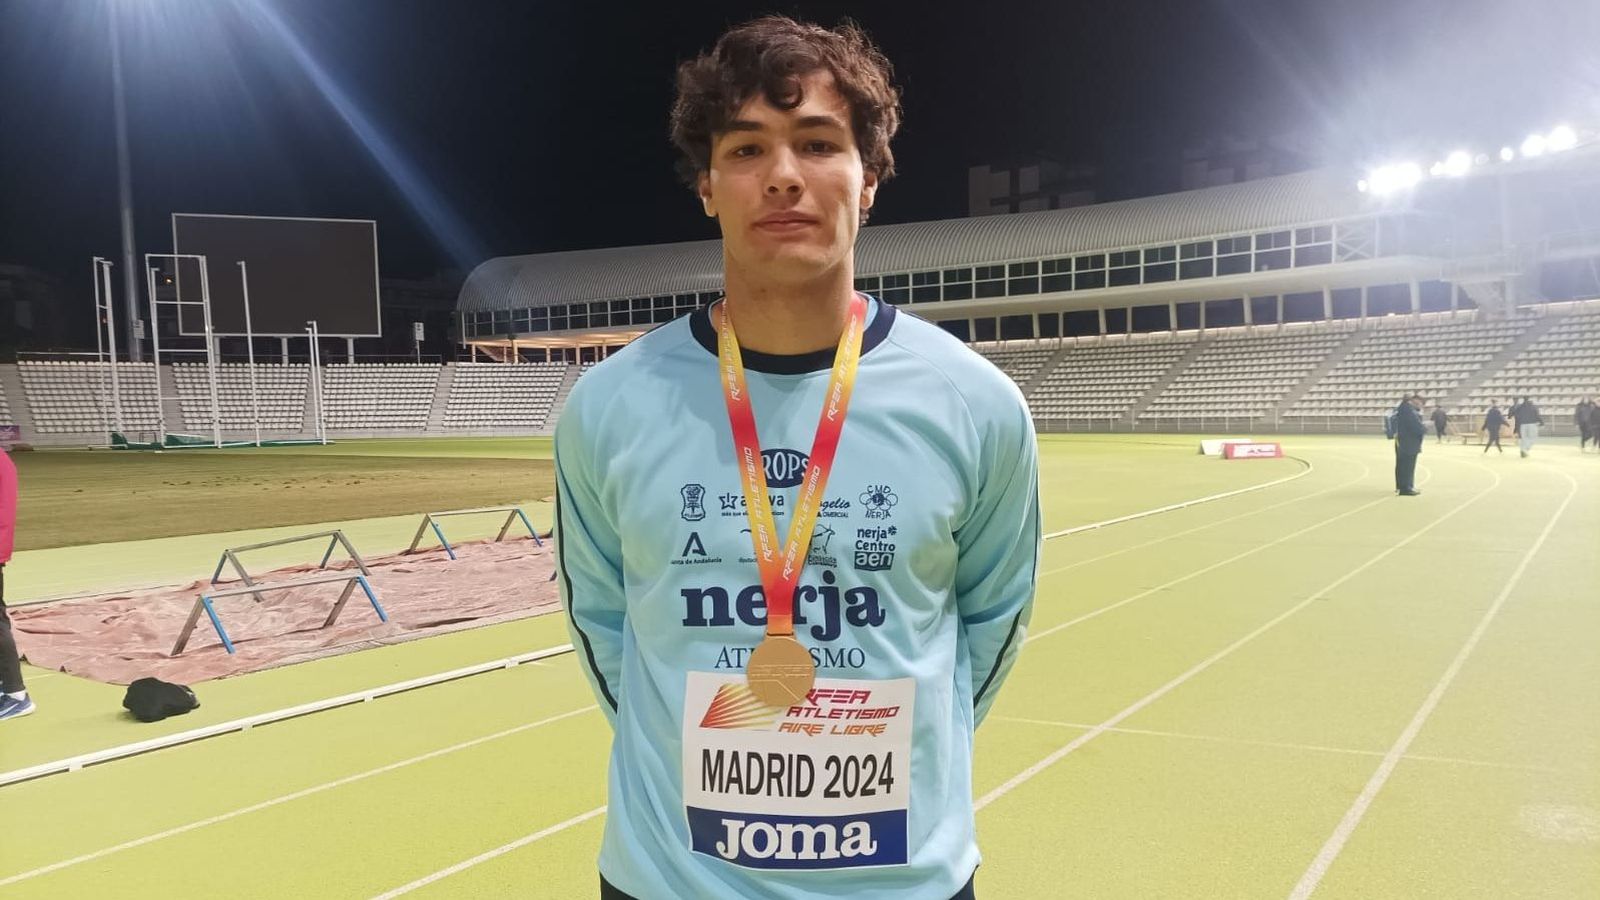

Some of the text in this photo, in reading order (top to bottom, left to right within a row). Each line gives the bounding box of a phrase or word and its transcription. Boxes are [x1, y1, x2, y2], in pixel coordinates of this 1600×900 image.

[827, 382, 843, 421] RFEA
[744, 447, 774, 562] RFEA ATLETISMO
[865, 510, 892, 520] NERJA
[783, 465, 821, 580] RFEA ATLETISMO
[857, 526, 887, 542] nerja
[856, 552, 894, 567] aen
[680, 570, 886, 642] nerja
[714, 646, 866, 669] ATSMO
[786, 706, 900, 720] ATLETISMO
[778, 722, 888, 737] AIRE LIBRE
[702, 748, 894, 799] MADRID 2024
